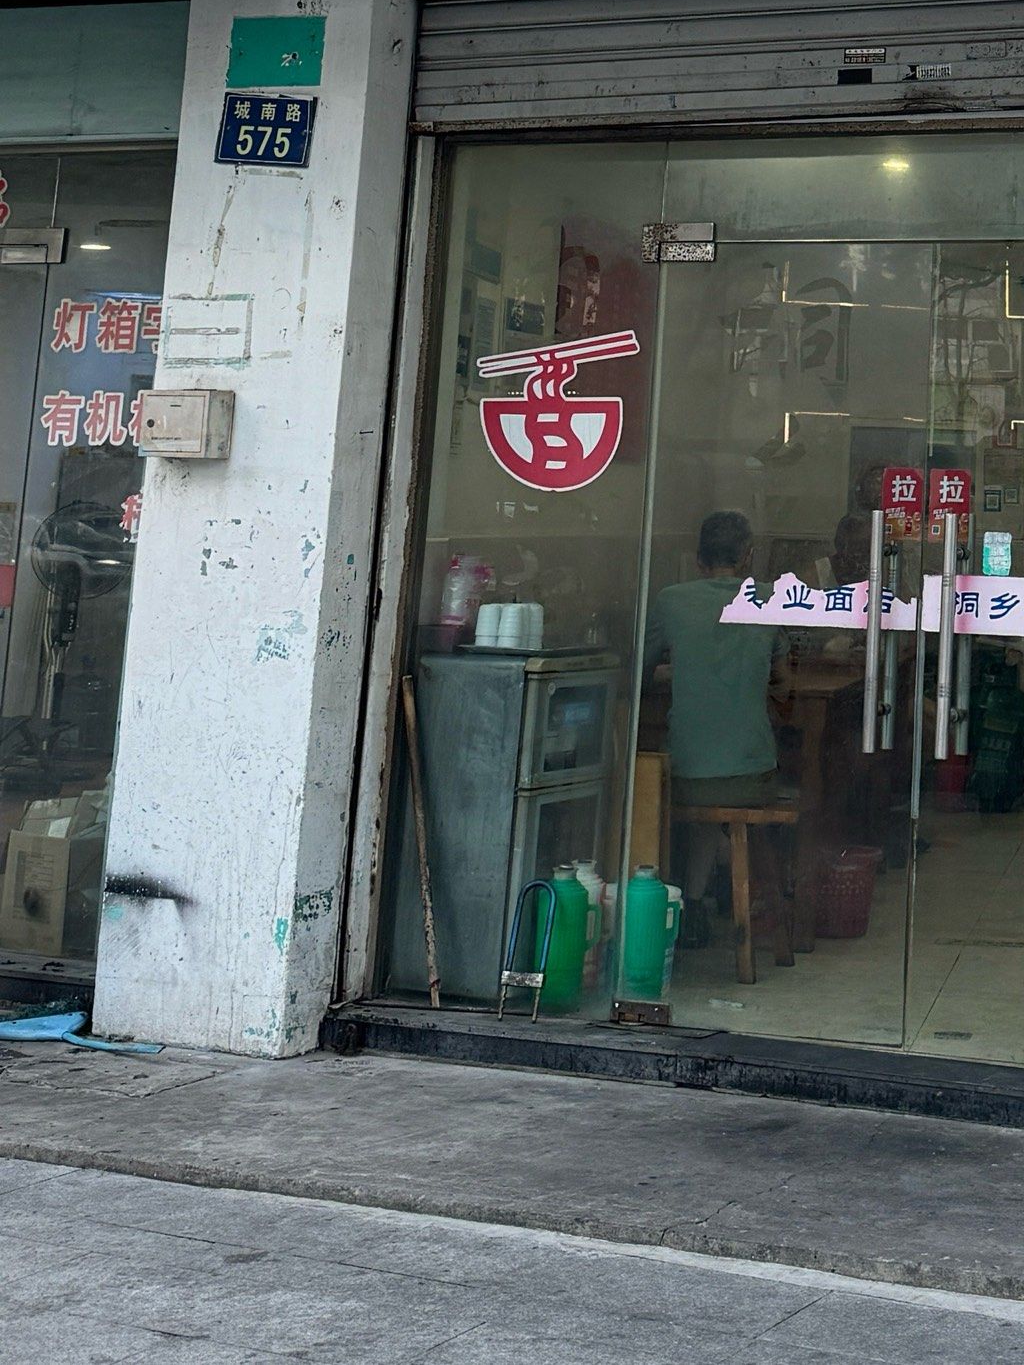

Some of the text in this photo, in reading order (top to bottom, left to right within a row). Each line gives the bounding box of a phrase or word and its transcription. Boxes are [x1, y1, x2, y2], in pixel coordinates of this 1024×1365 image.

[234, 100, 302, 123] 城南路
[236, 125, 292, 158] 575
[891, 475, 917, 503] 拉
[939, 476, 965, 504] 拉
